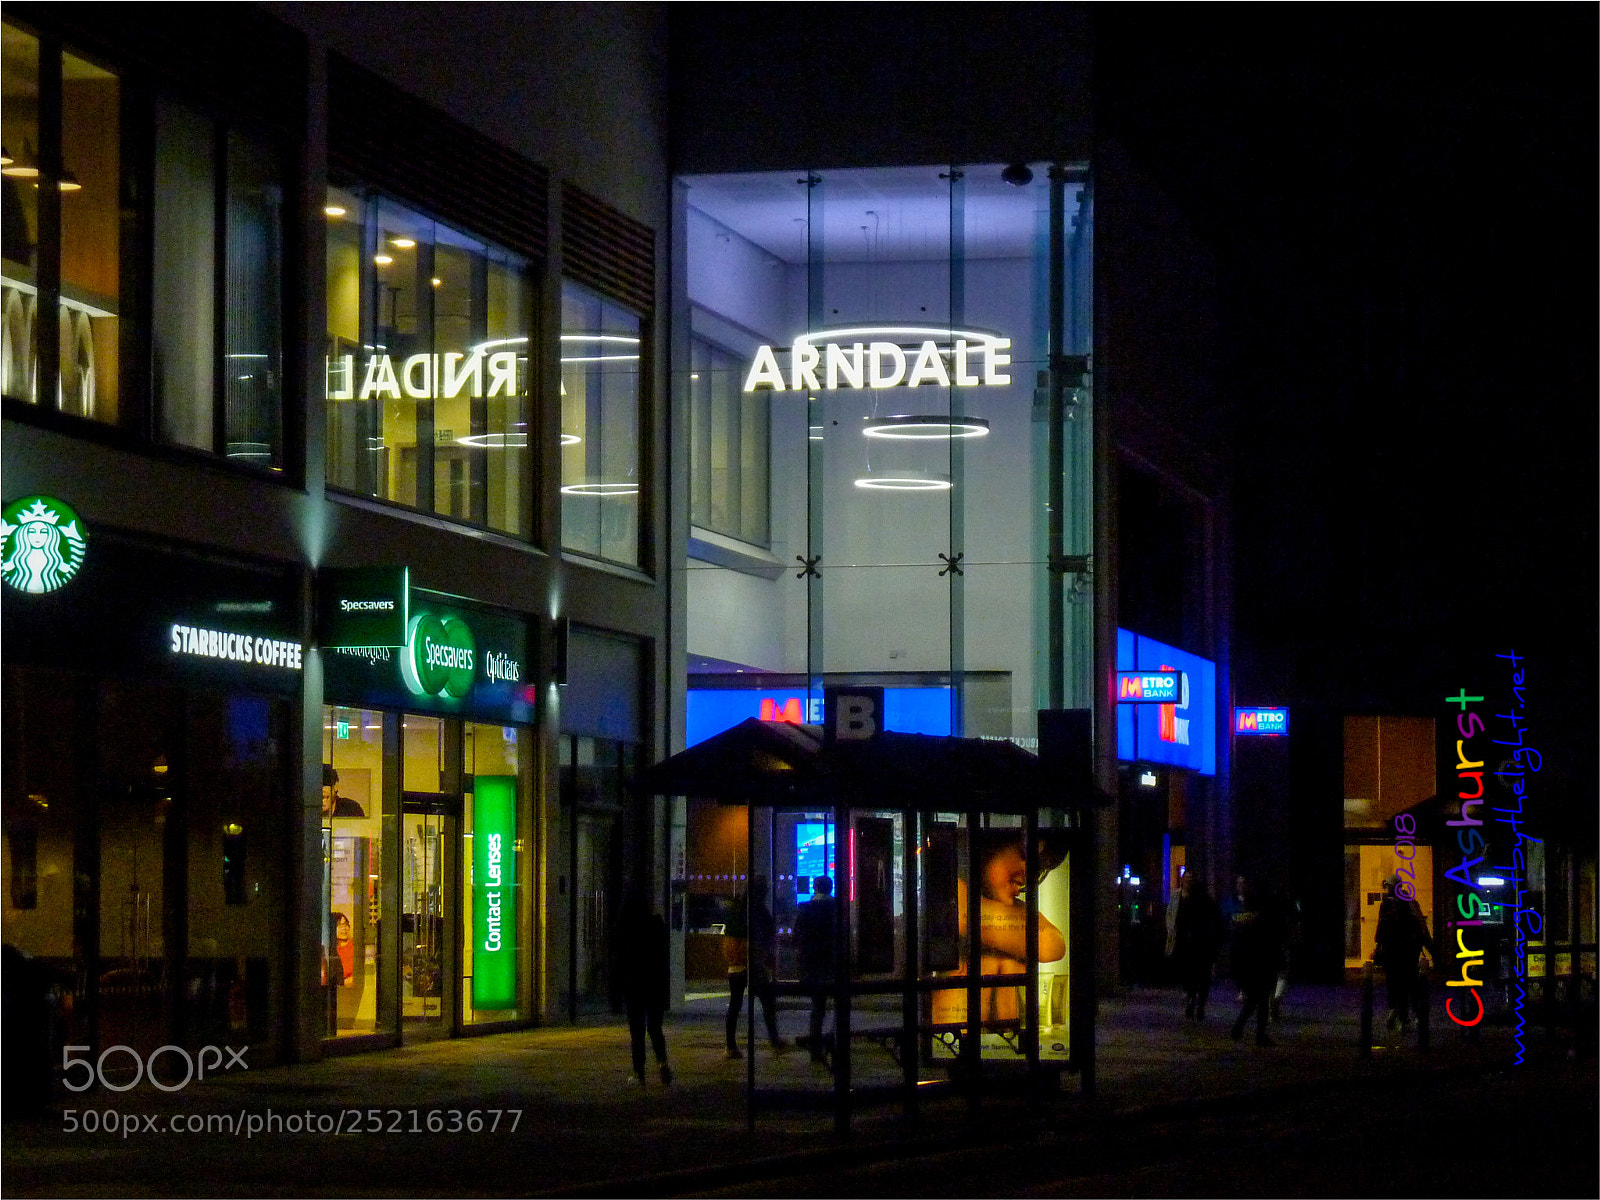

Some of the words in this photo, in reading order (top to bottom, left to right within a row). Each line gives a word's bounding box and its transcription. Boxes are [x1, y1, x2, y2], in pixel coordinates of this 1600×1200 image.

[744, 339, 1011, 392] ARNDALE
[340, 599, 394, 612] Specsavers
[172, 624, 253, 663] STARBUCKS
[254, 637, 302, 669] COFFEE
[425, 636, 473, 671] Specsavers
[486, 650, 519, 684] Opticians
[1120, 677, 1174, 699] METRO
[1144, 689, 1174, 698] BANK
[836, 696, 876, 740] B
[1238, 712, 1284, 731] METRO
[1258, 722, 1284, 730] BANK
[485, 833, 502, 887] Lenses
[485, 891, 502, 952] Contact
